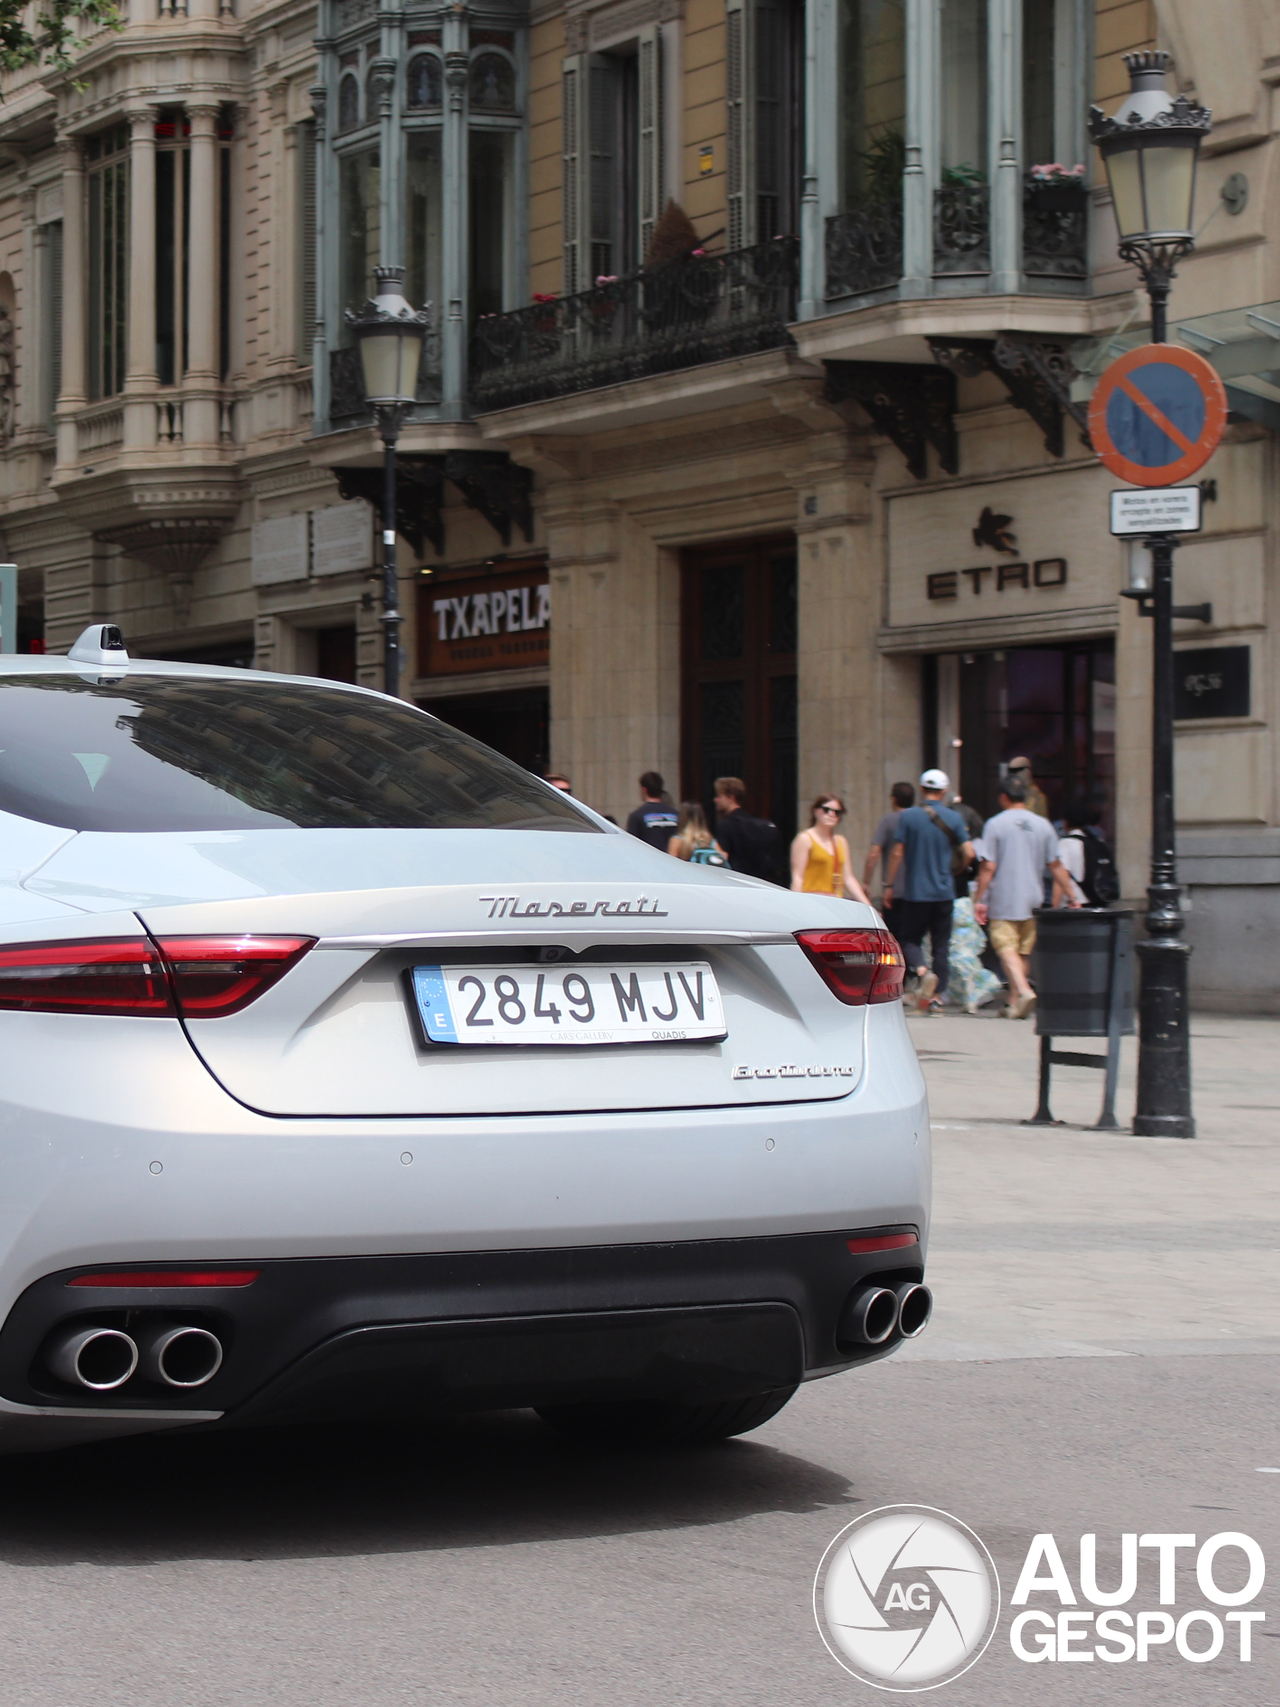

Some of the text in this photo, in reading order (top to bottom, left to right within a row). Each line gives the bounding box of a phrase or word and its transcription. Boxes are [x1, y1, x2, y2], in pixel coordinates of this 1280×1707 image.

[926, 558, 1067, 600] ETRO
[433, 584, 551, 640] TXAPELA
[478, 893, 669, 918] Maserati
[457, 971, 705, 1027] 2849 MJV
[435, 1013, 448, 1028] E
[550, 1031, 614, 1041] CARS GALLERY
[651, 1030, 687, 1040] QUADIS
